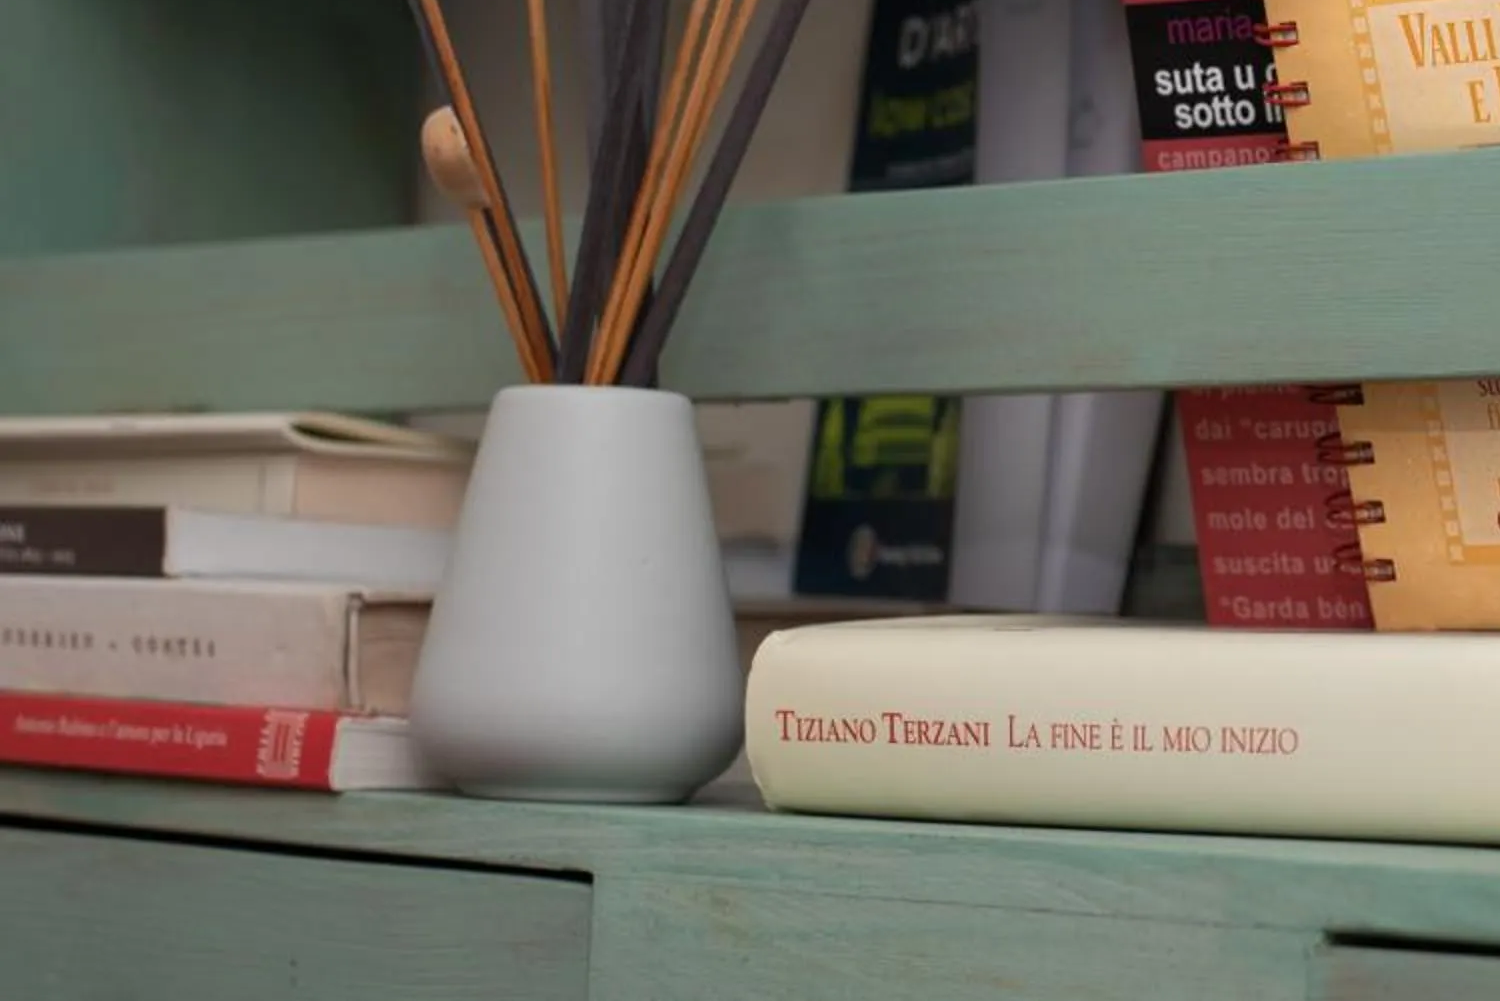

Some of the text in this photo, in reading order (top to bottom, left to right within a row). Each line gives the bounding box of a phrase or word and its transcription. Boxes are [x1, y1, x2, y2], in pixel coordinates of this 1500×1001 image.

[1167, 8, 1253, 45] maria
[1399, 12, 1498, 68] VALLI
[1155, 60, 1225, 97] suta
[1233, 64, 1256, 91] u
[1174, 94, 1256, 130] sotto
[1467, 76, 1492, 125] E
[1195, 416, 1232, 441] dai
[1201, 462, 1294, 487] sembra
[1208, 507, 1267, 530] mole
[1276, 506, 1314, 530] del
[1214, 551, 1304, 576] suscita
[775, 709, 877, 747] TIZIANO
[882, 712, 990, 750] TERZANI
[1007, 715, 1042, 750] LA
[1050, 721, 1102, 752] FINE
[1132, 725, 1154, 753] IL
[1161, 726, 1210, 755] MIO
[1219, 727, 1299, 757] INIZIO
